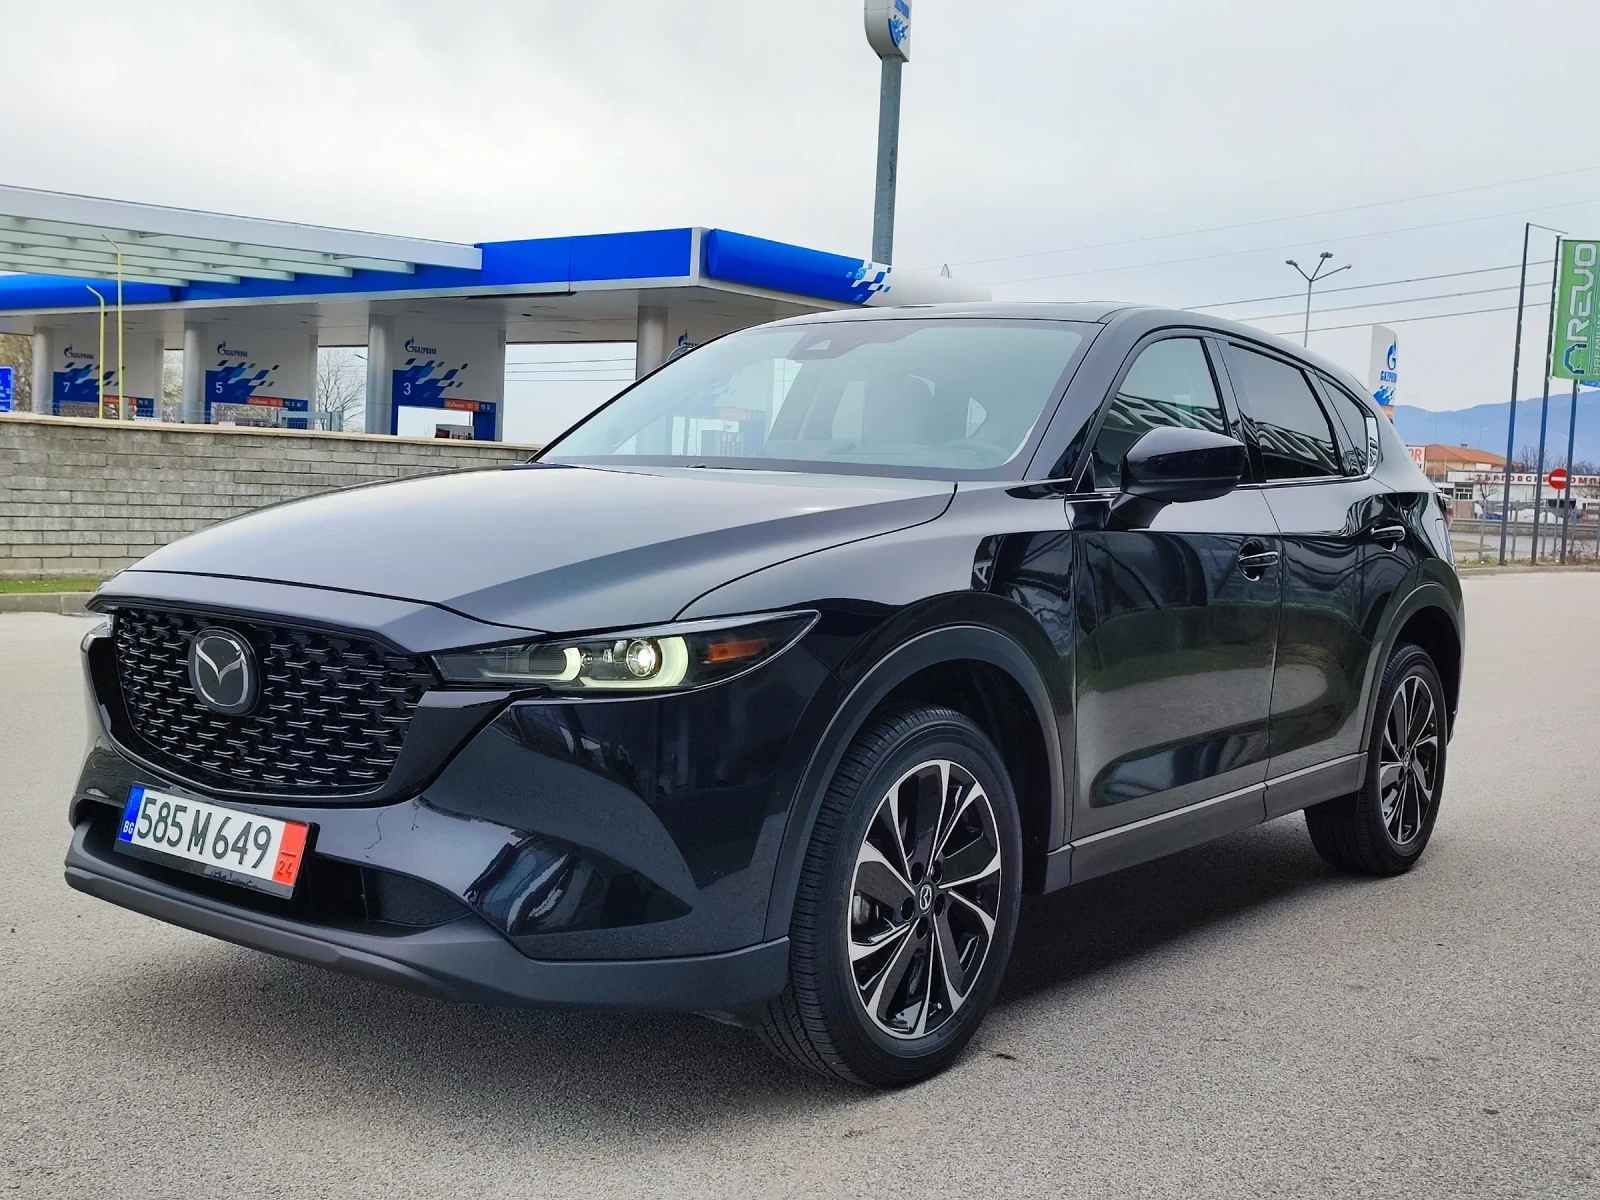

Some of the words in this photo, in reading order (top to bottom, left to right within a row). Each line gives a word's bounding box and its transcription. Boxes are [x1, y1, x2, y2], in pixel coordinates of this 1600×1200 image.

[63, 382, 71, 393] 7
[215, 382, 223, 394] 5
[403, 382, 411, 395] 3
[122, 820, 135, 835] BG
[276, 859, 293, 878] 24
